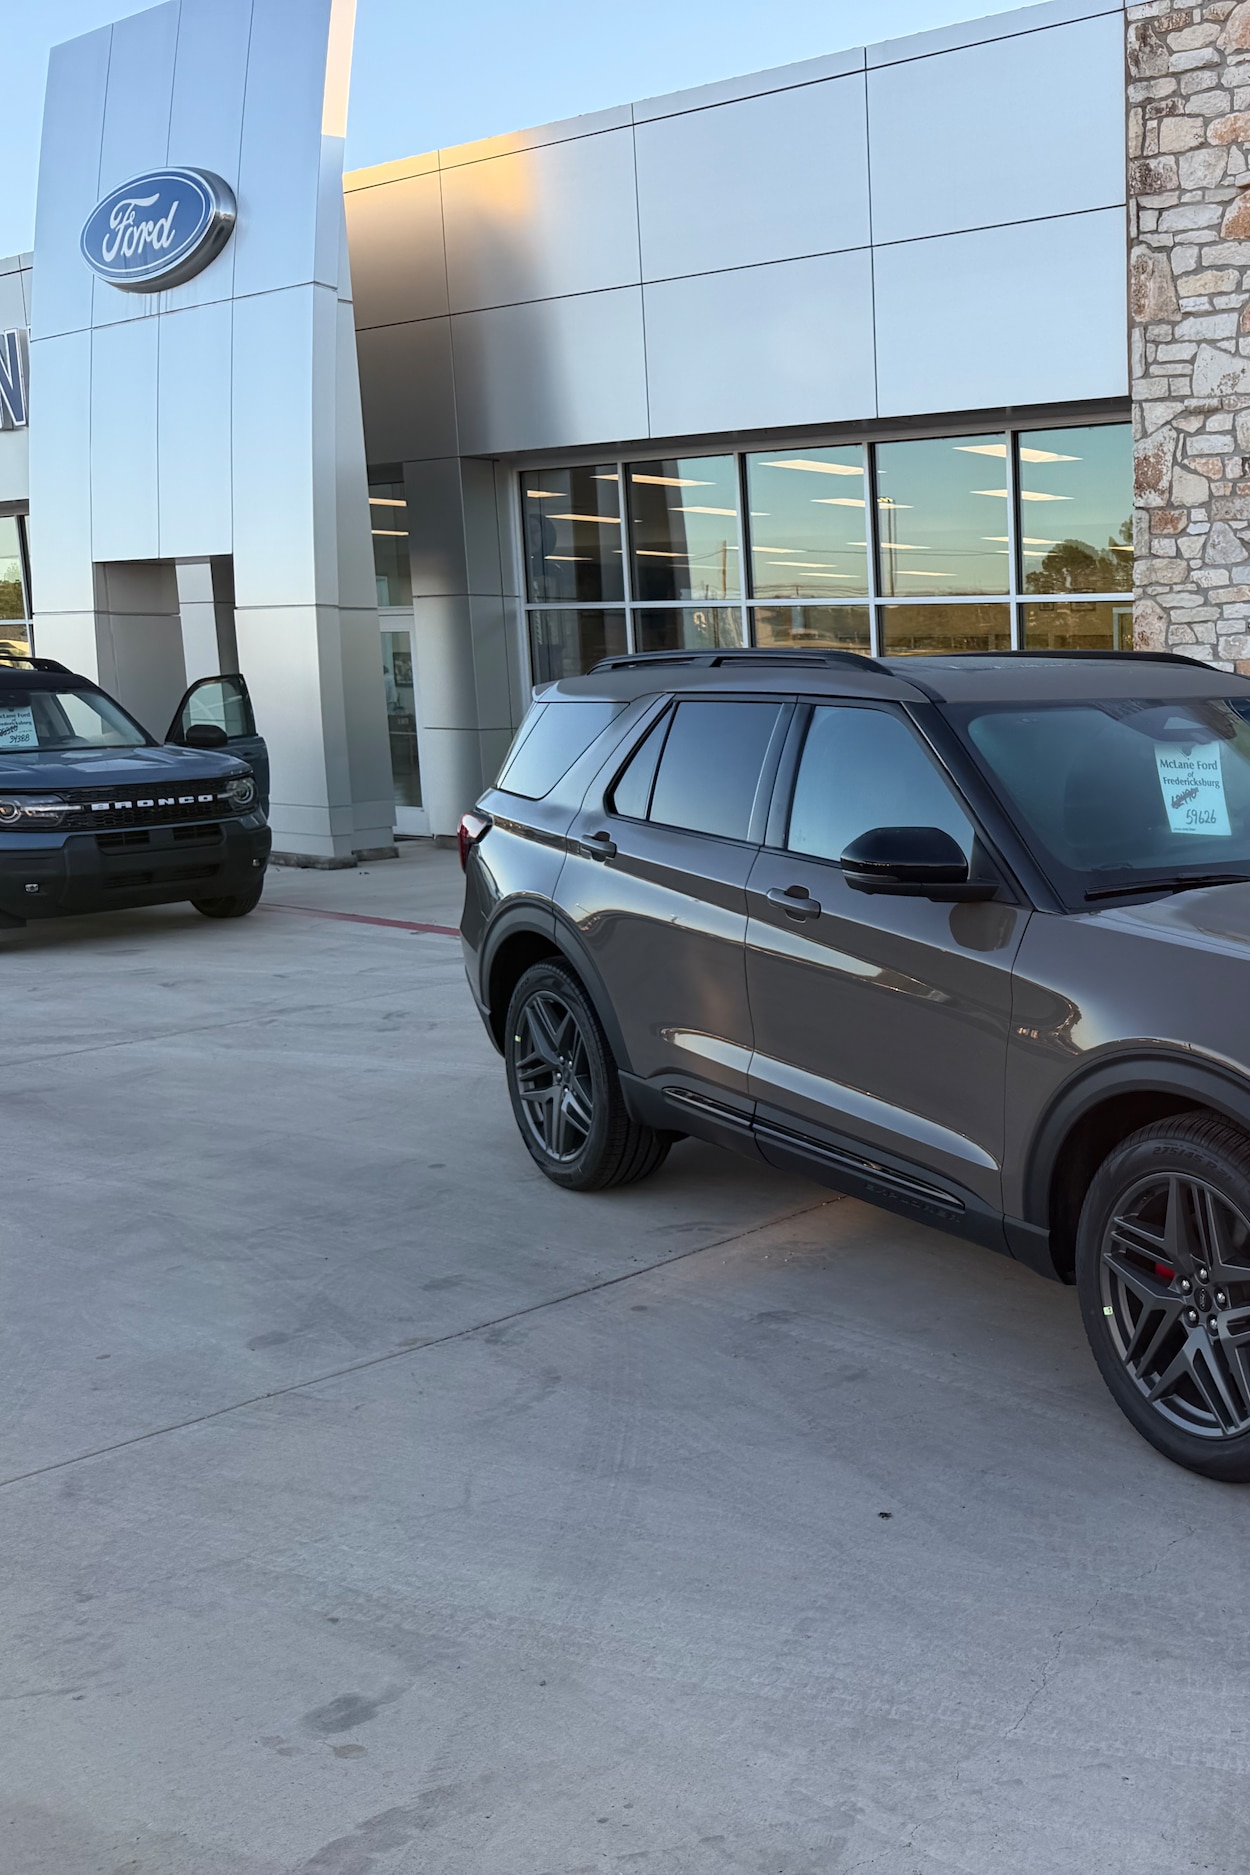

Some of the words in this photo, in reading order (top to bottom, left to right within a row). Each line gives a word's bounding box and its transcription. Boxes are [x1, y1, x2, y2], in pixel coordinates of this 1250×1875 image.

[102, 193, 179, 262] Ford
[1160, 759, 1195, 770] McLane
[1197, 760, 1218, 771] Ford
[1163, 776, 1220, 789] Fredericksburg
[91, 794, 213, 811] BRONCO
[1186, 809, 1217, 825] 59626
